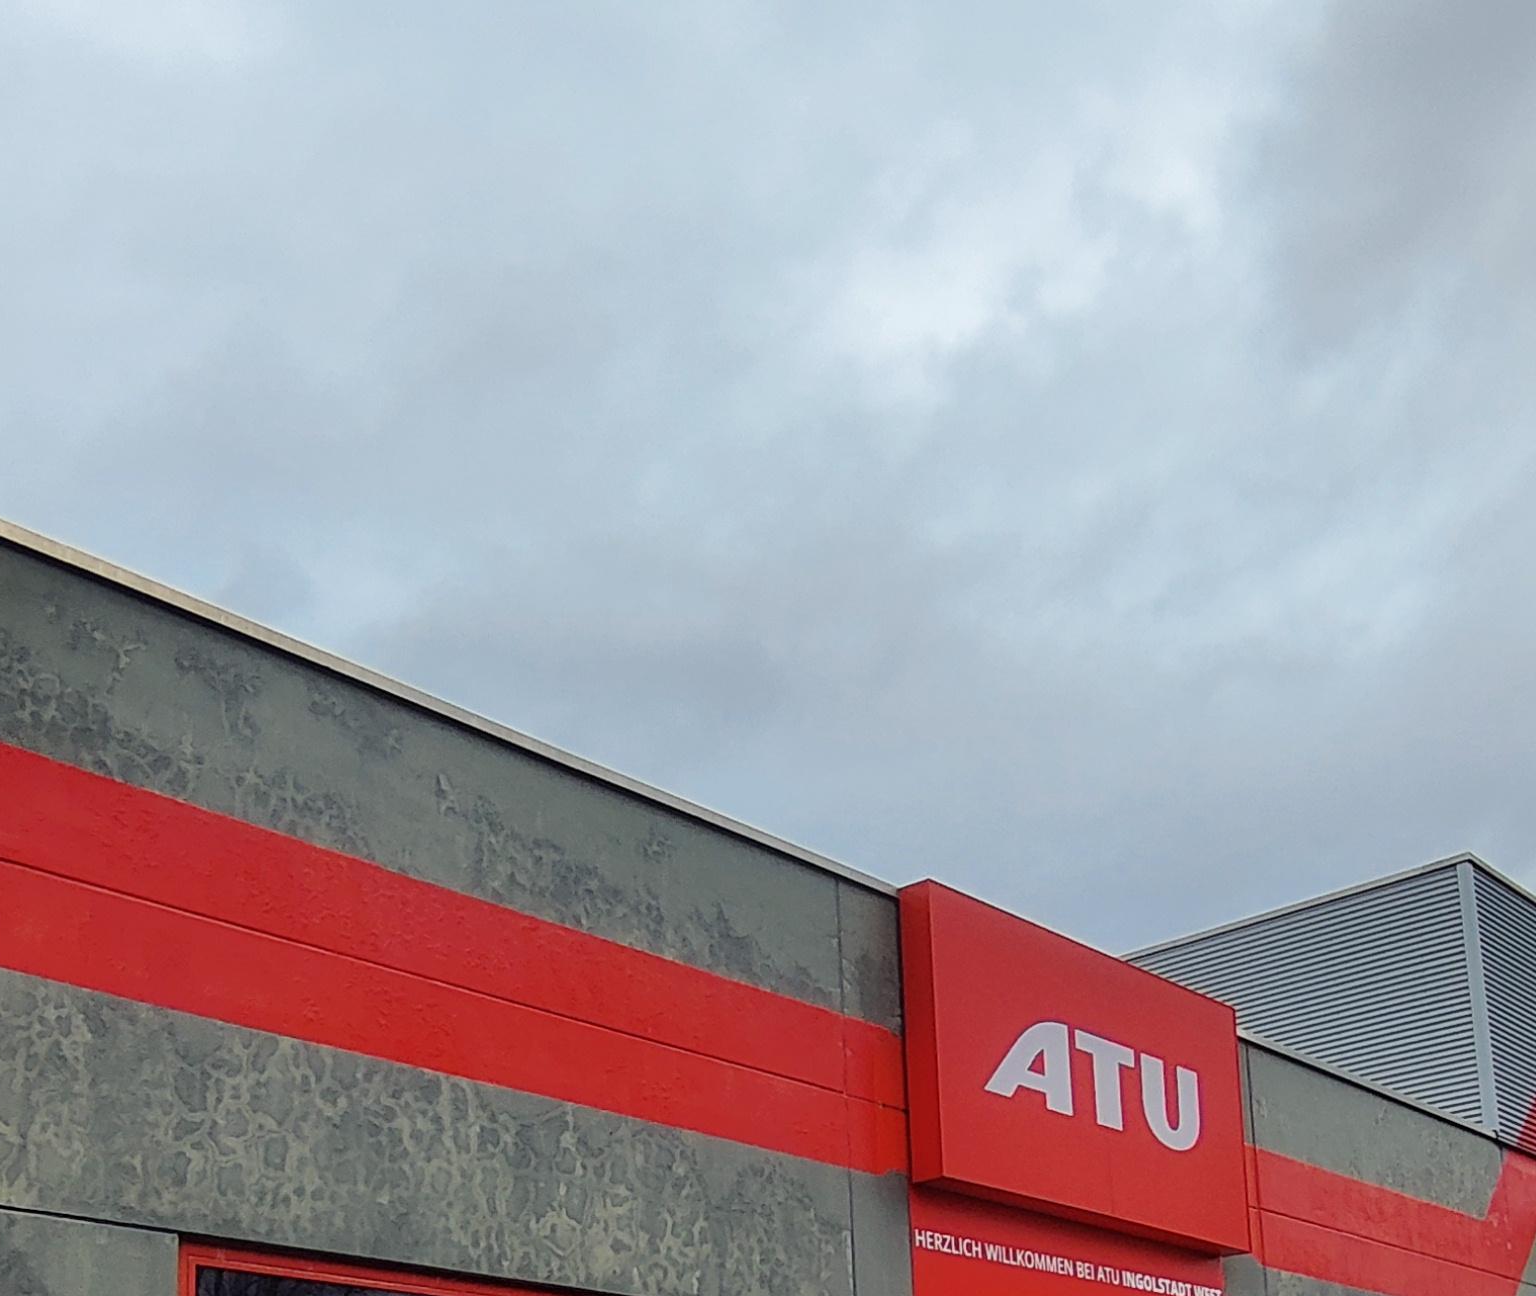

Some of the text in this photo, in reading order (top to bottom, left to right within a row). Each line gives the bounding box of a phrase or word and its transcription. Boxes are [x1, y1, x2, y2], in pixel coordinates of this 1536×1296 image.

[983, 1020, 1201, 1151] ATU
[914, 1228, 982, 1259] HERZLICH
[984, 1242, 1074, 1277] WILLKOMMEN
[1076, 1261, 1095, 1281] BEI
[1097, 1265, 1120, 1286] ATU
